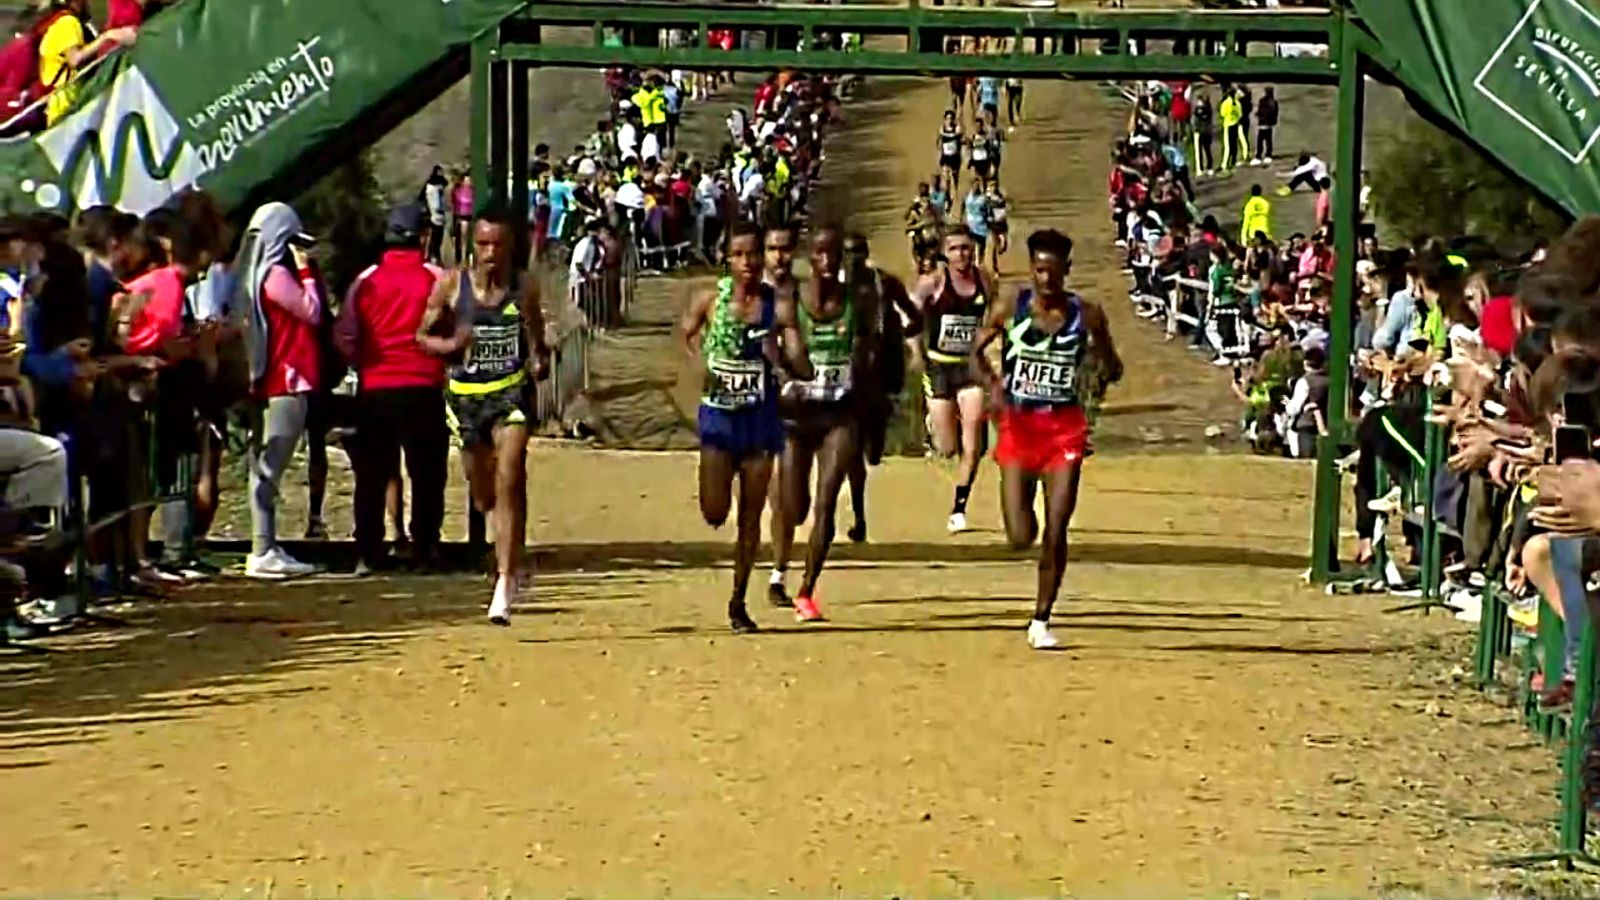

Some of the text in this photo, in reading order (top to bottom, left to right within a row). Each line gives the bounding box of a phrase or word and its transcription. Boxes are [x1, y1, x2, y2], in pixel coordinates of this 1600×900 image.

[205, 70, 273, 120] provincia
[267, 57, 287, 74] en
[1514, 55, 1586, 121] SEVILLA
[1019, 362, 1070, 384] KIFLE
